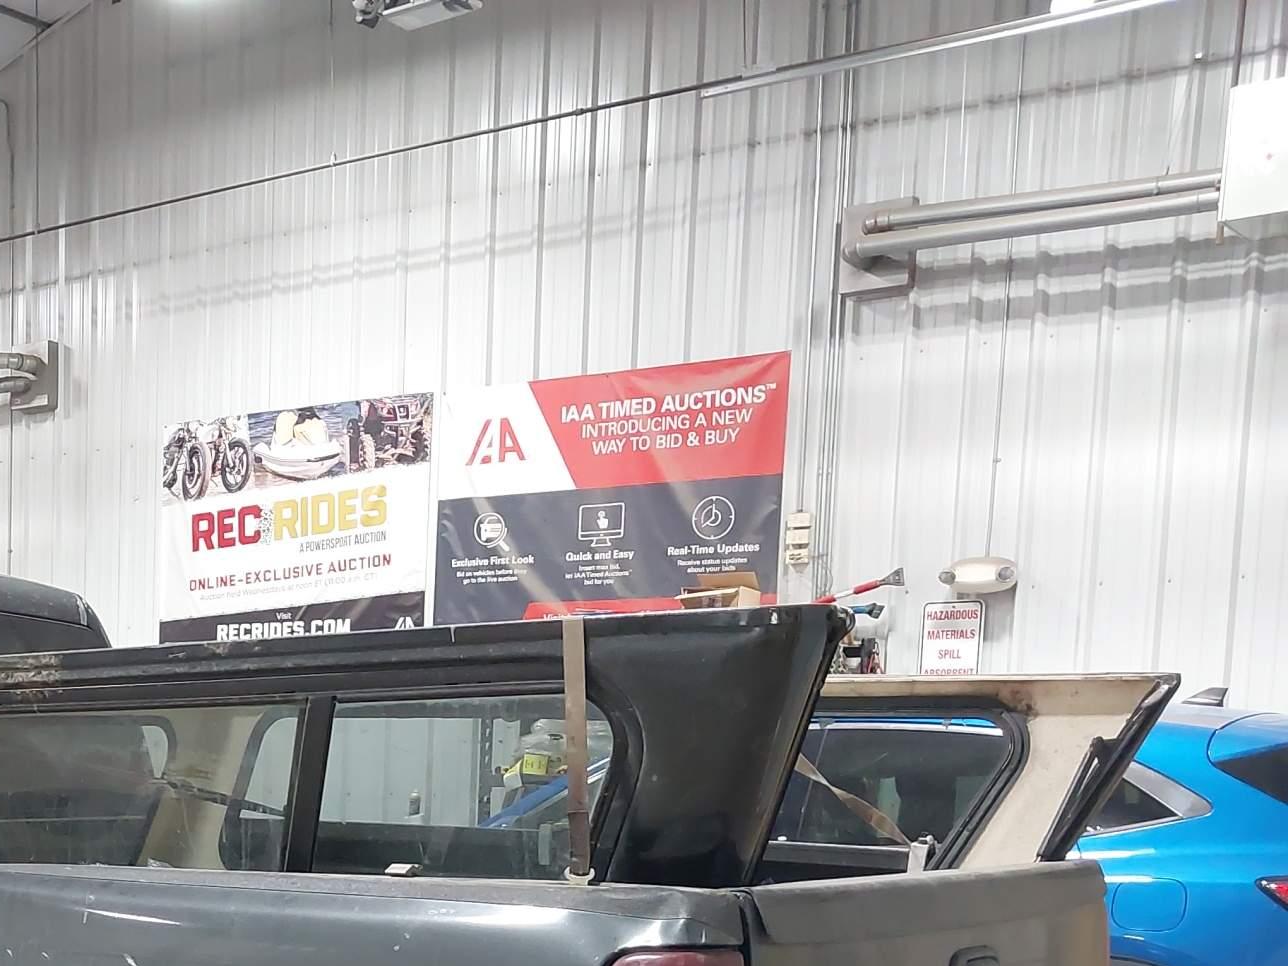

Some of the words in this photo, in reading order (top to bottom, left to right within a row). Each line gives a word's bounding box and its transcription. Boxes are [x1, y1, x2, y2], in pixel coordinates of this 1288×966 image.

[561, 403, 595, 423] IAA
[598, 397, 656, 419] TIMED
[581, 415, 690, 439] INTRODUCING
[694, 413, 707, 428] A
[712, 408, 753, 426] NEW
[592, 438, 626, 455] WAY
[630, 436, 650, 451] TO
[655, 434, 683, 449] BID
[686, 433, 700, 447] &
[705, 427, 741, 445] BUY
[191, 504, 262, 553] REC
[272, 484, 388, 542] RIDES
[299, 543, 305, 553] A
[305, 535, 352, 552] POWERSPORT
[354, 530, 387, 545] AUCTION
[667, 545, 715, 556] Real-Time
[717, 543, 760, 555] Updates
[451, 557, 489, 568] Exclusive
[490, 556, 510, 566] First
[511, 554, 535, 565] Look
[565, 551, 593, 562] Quick
[594, 550, 612, 560] and
[612, 549, 635, 560] Easy
[189, 562, 323, 591] ONLINE-EXCLUSIVE
[327, 553, 392, 574] AUCTION
[276, 612, 292, 620] Visit
[926, 609, 979, 621] HAZARDOUS
[216, 618, 351, 642] RECRIDES.COM
[927, 628, 976, 640] MATERIALS
[937, 649, 962, 660] SPILL
